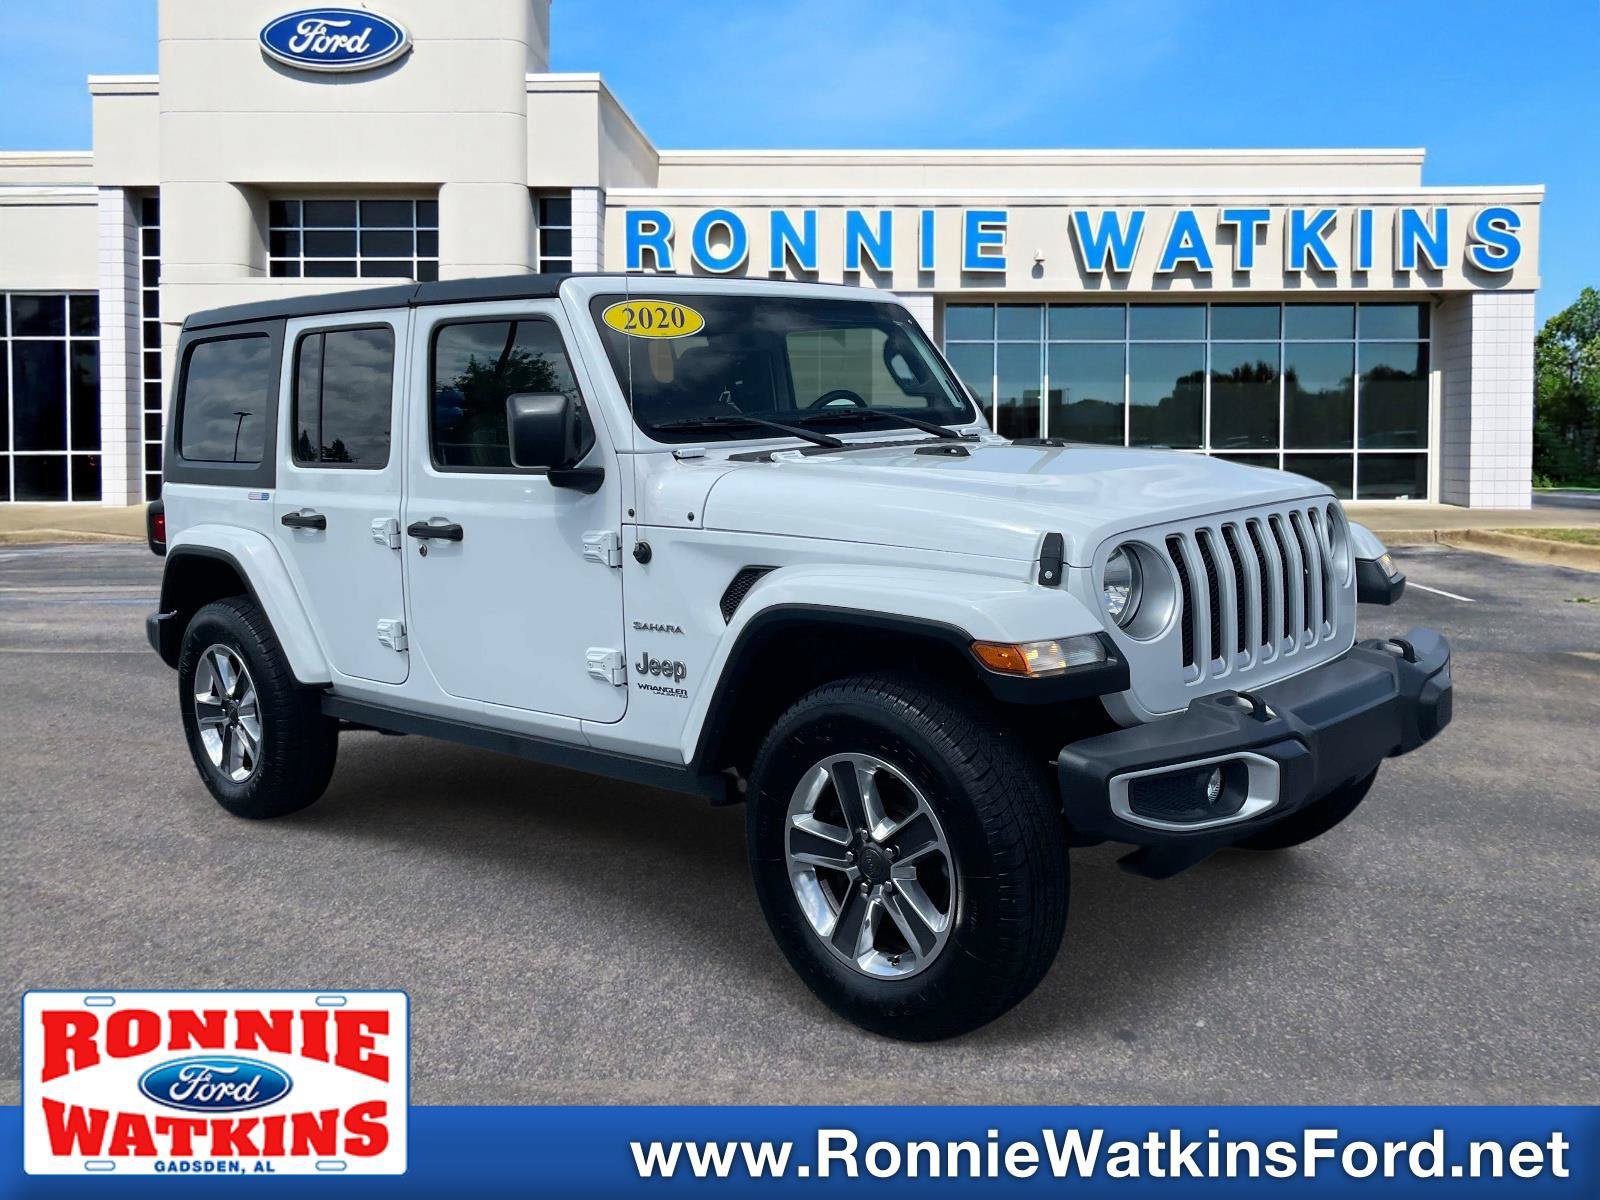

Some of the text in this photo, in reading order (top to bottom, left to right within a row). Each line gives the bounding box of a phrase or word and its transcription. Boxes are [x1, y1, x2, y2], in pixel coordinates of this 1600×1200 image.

[288, 18, 373, 54] Ford
[625, 206, 1523, 273] RONNIE WATKINS
[622, 307, 685, 330] 2020
[633, 621, 685, 635] SAHARA
[635, 651, 687, 683] Jeep
[637, 683, 688, 696] WRANGLER
